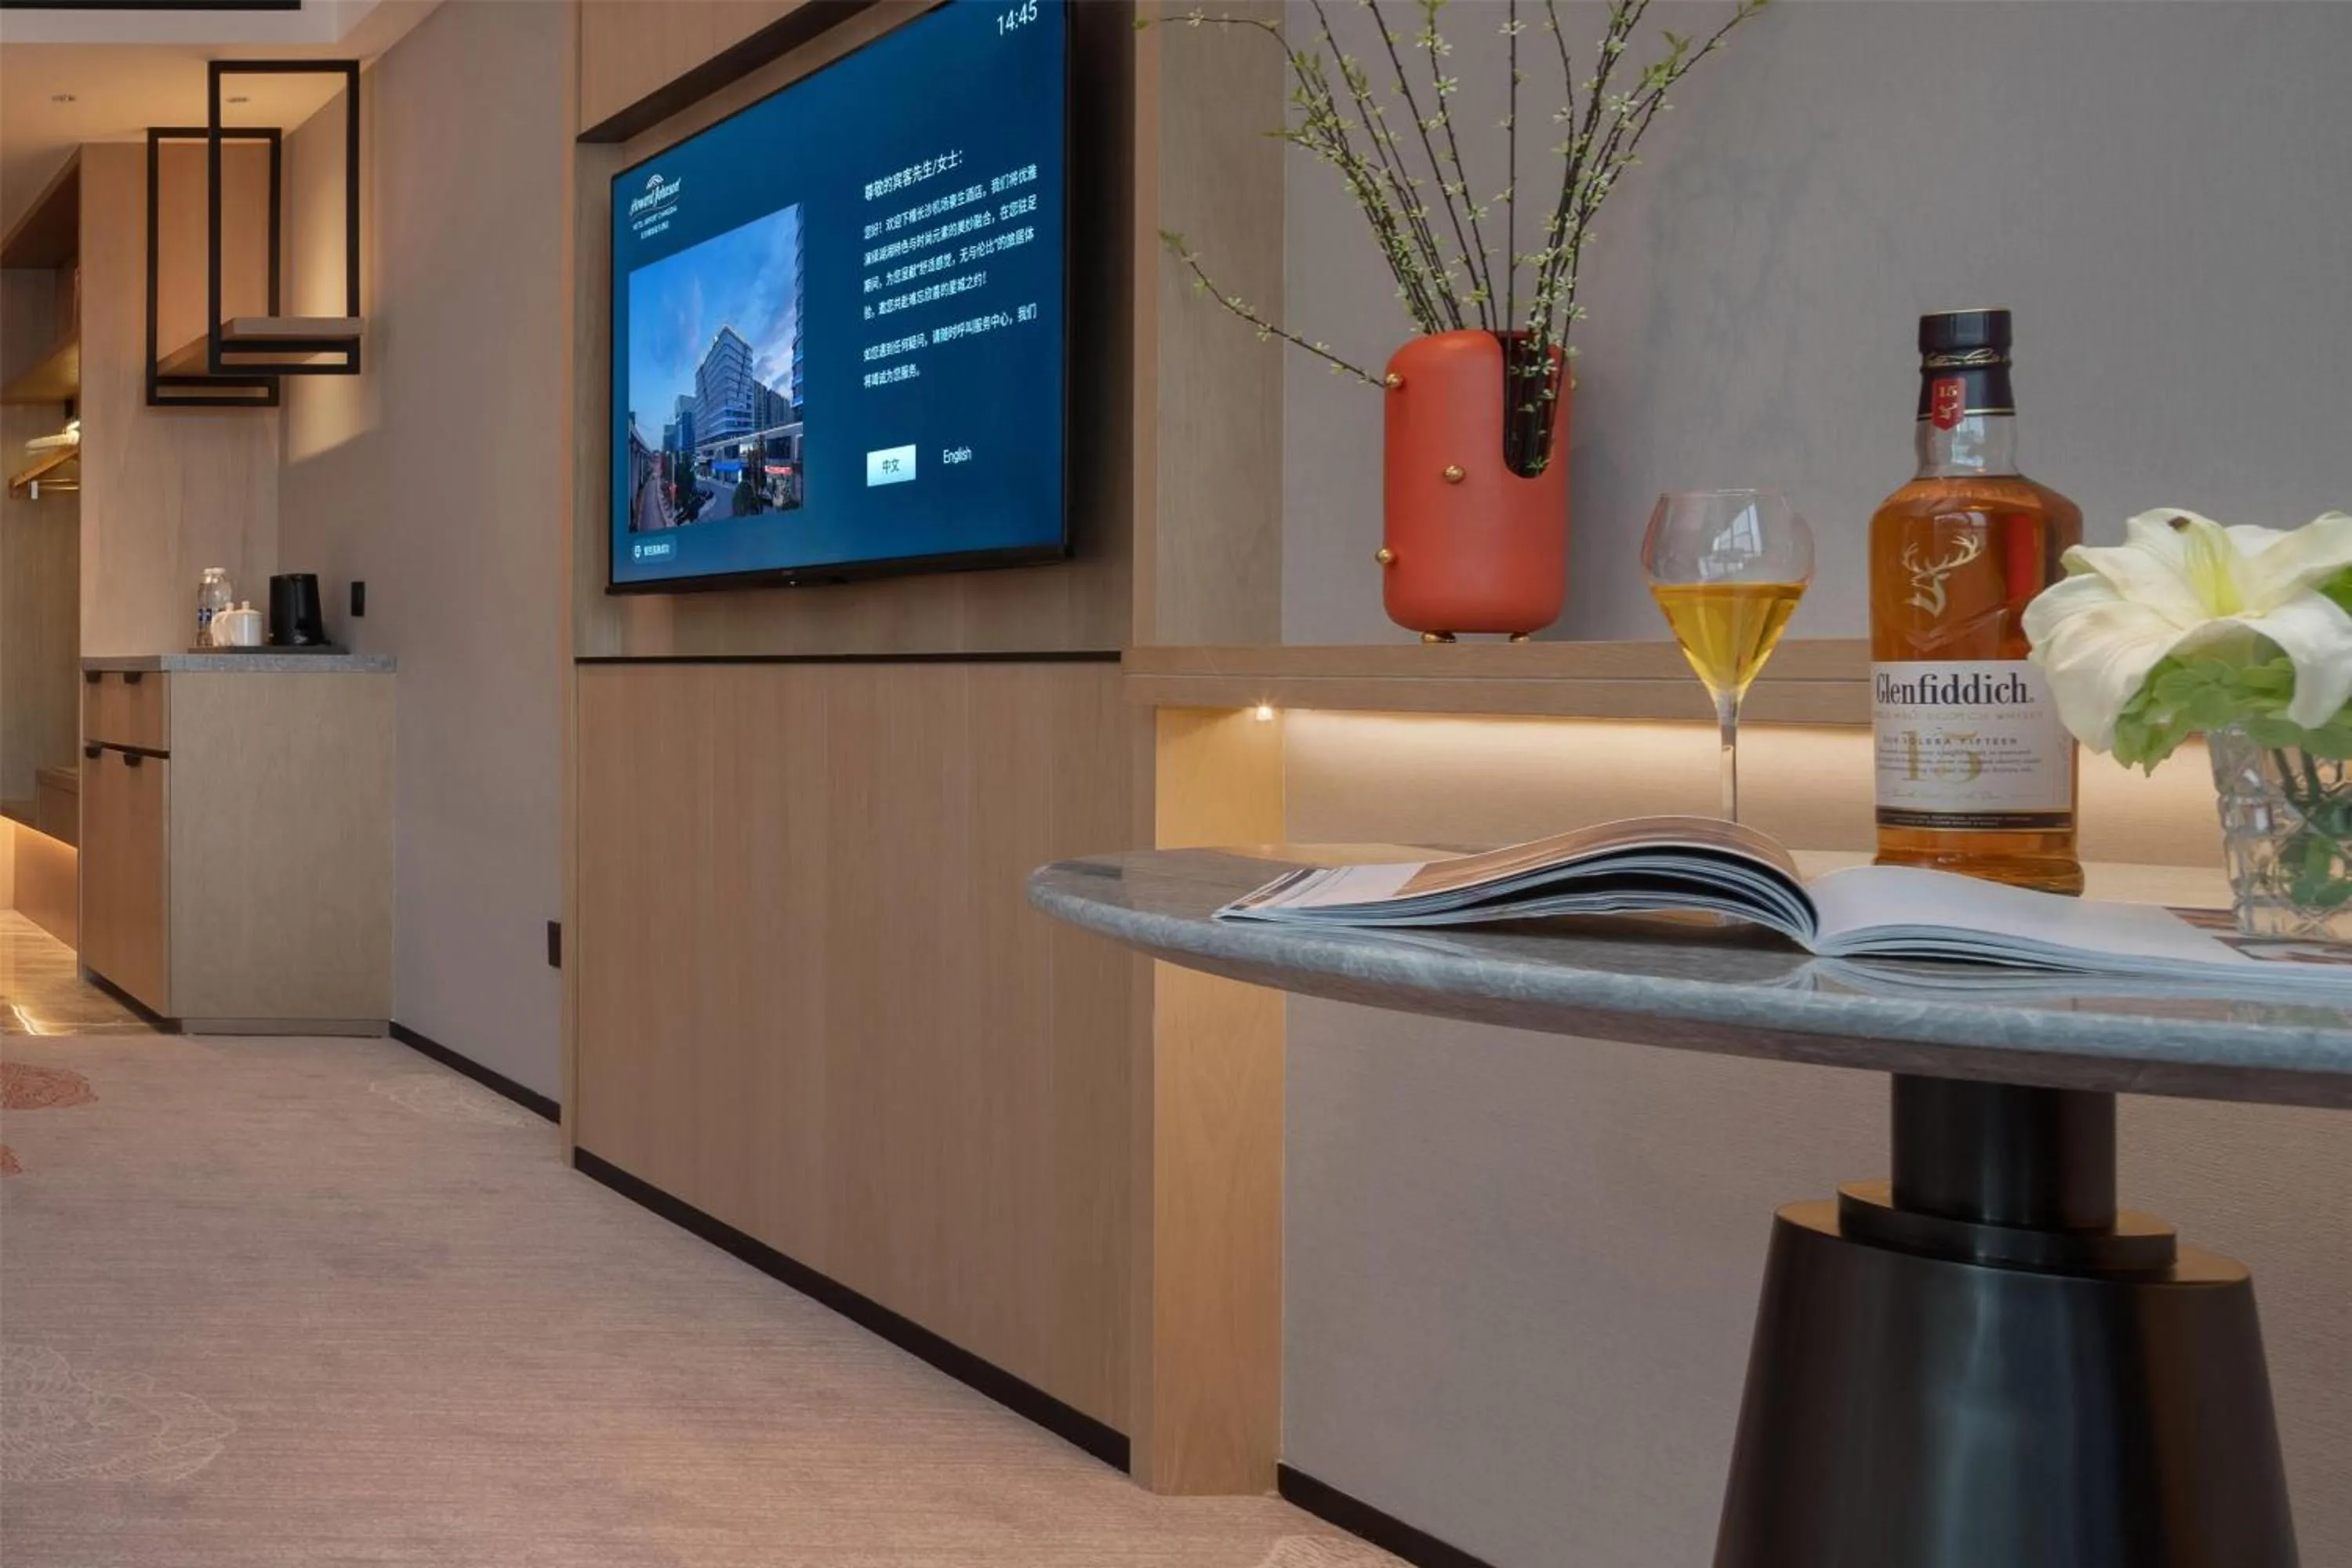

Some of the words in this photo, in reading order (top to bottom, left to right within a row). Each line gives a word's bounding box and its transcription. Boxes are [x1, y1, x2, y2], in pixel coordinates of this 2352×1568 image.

[996, 0, 1037, 36] 14:45
[882, 459, 900, 474] 中文
[943, 446, 973, 464] English
[1876, 672, 2027, 705] Glenfiddich
